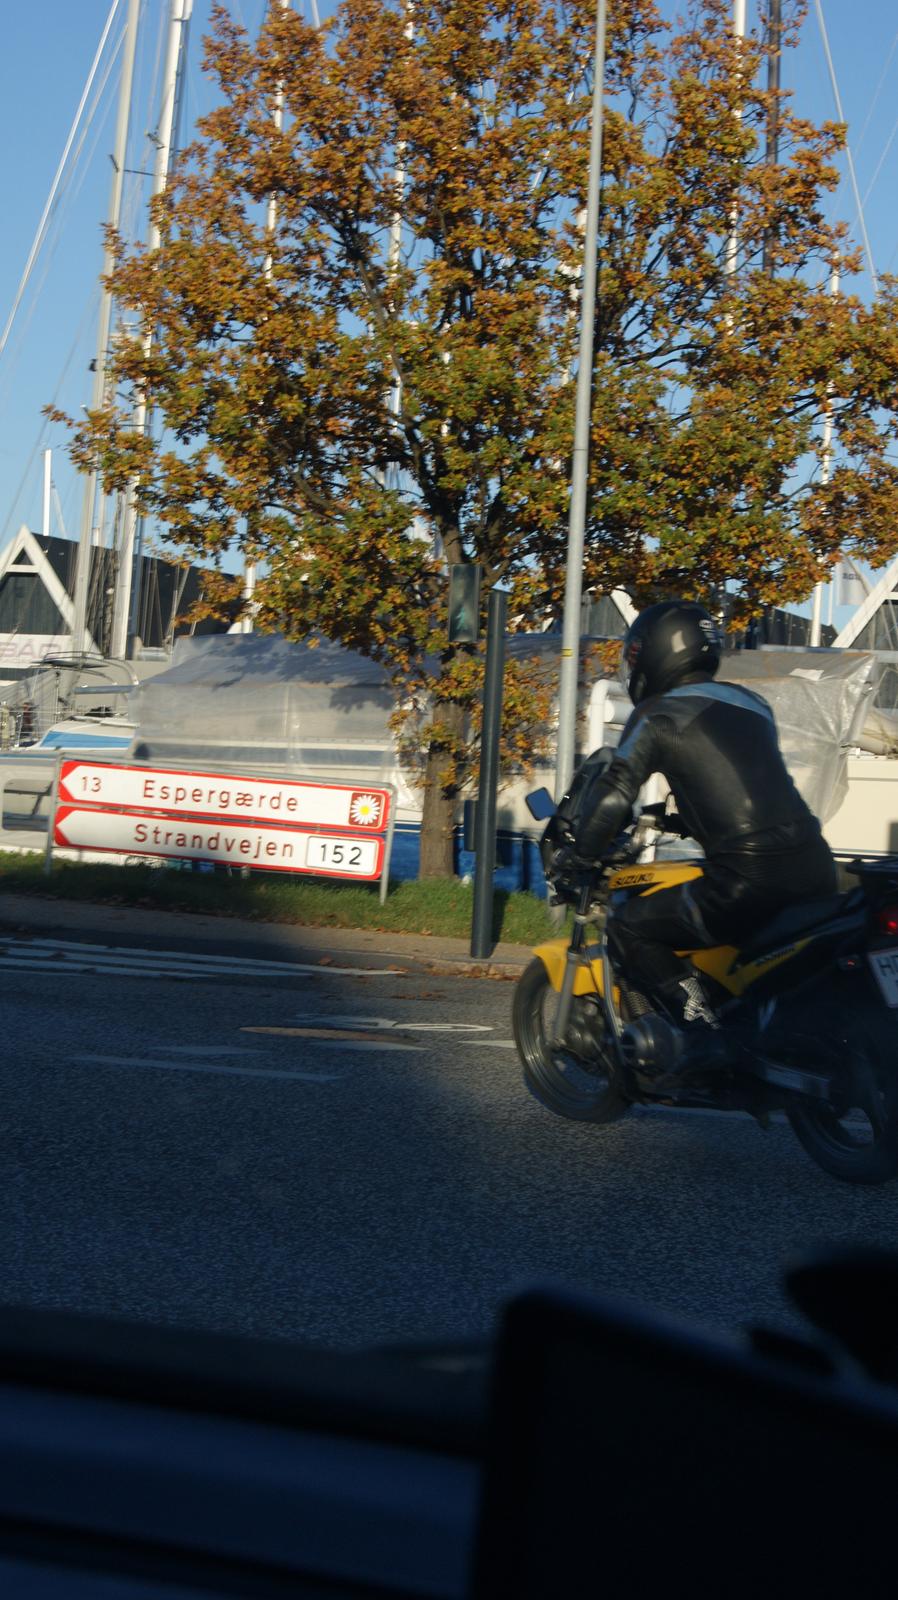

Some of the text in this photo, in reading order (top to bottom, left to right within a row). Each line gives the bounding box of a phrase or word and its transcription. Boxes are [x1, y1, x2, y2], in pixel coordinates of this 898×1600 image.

[80, 775, 298, 811] 13 Espergærde
[134, 823, 363, 865] Strandvejen 152
